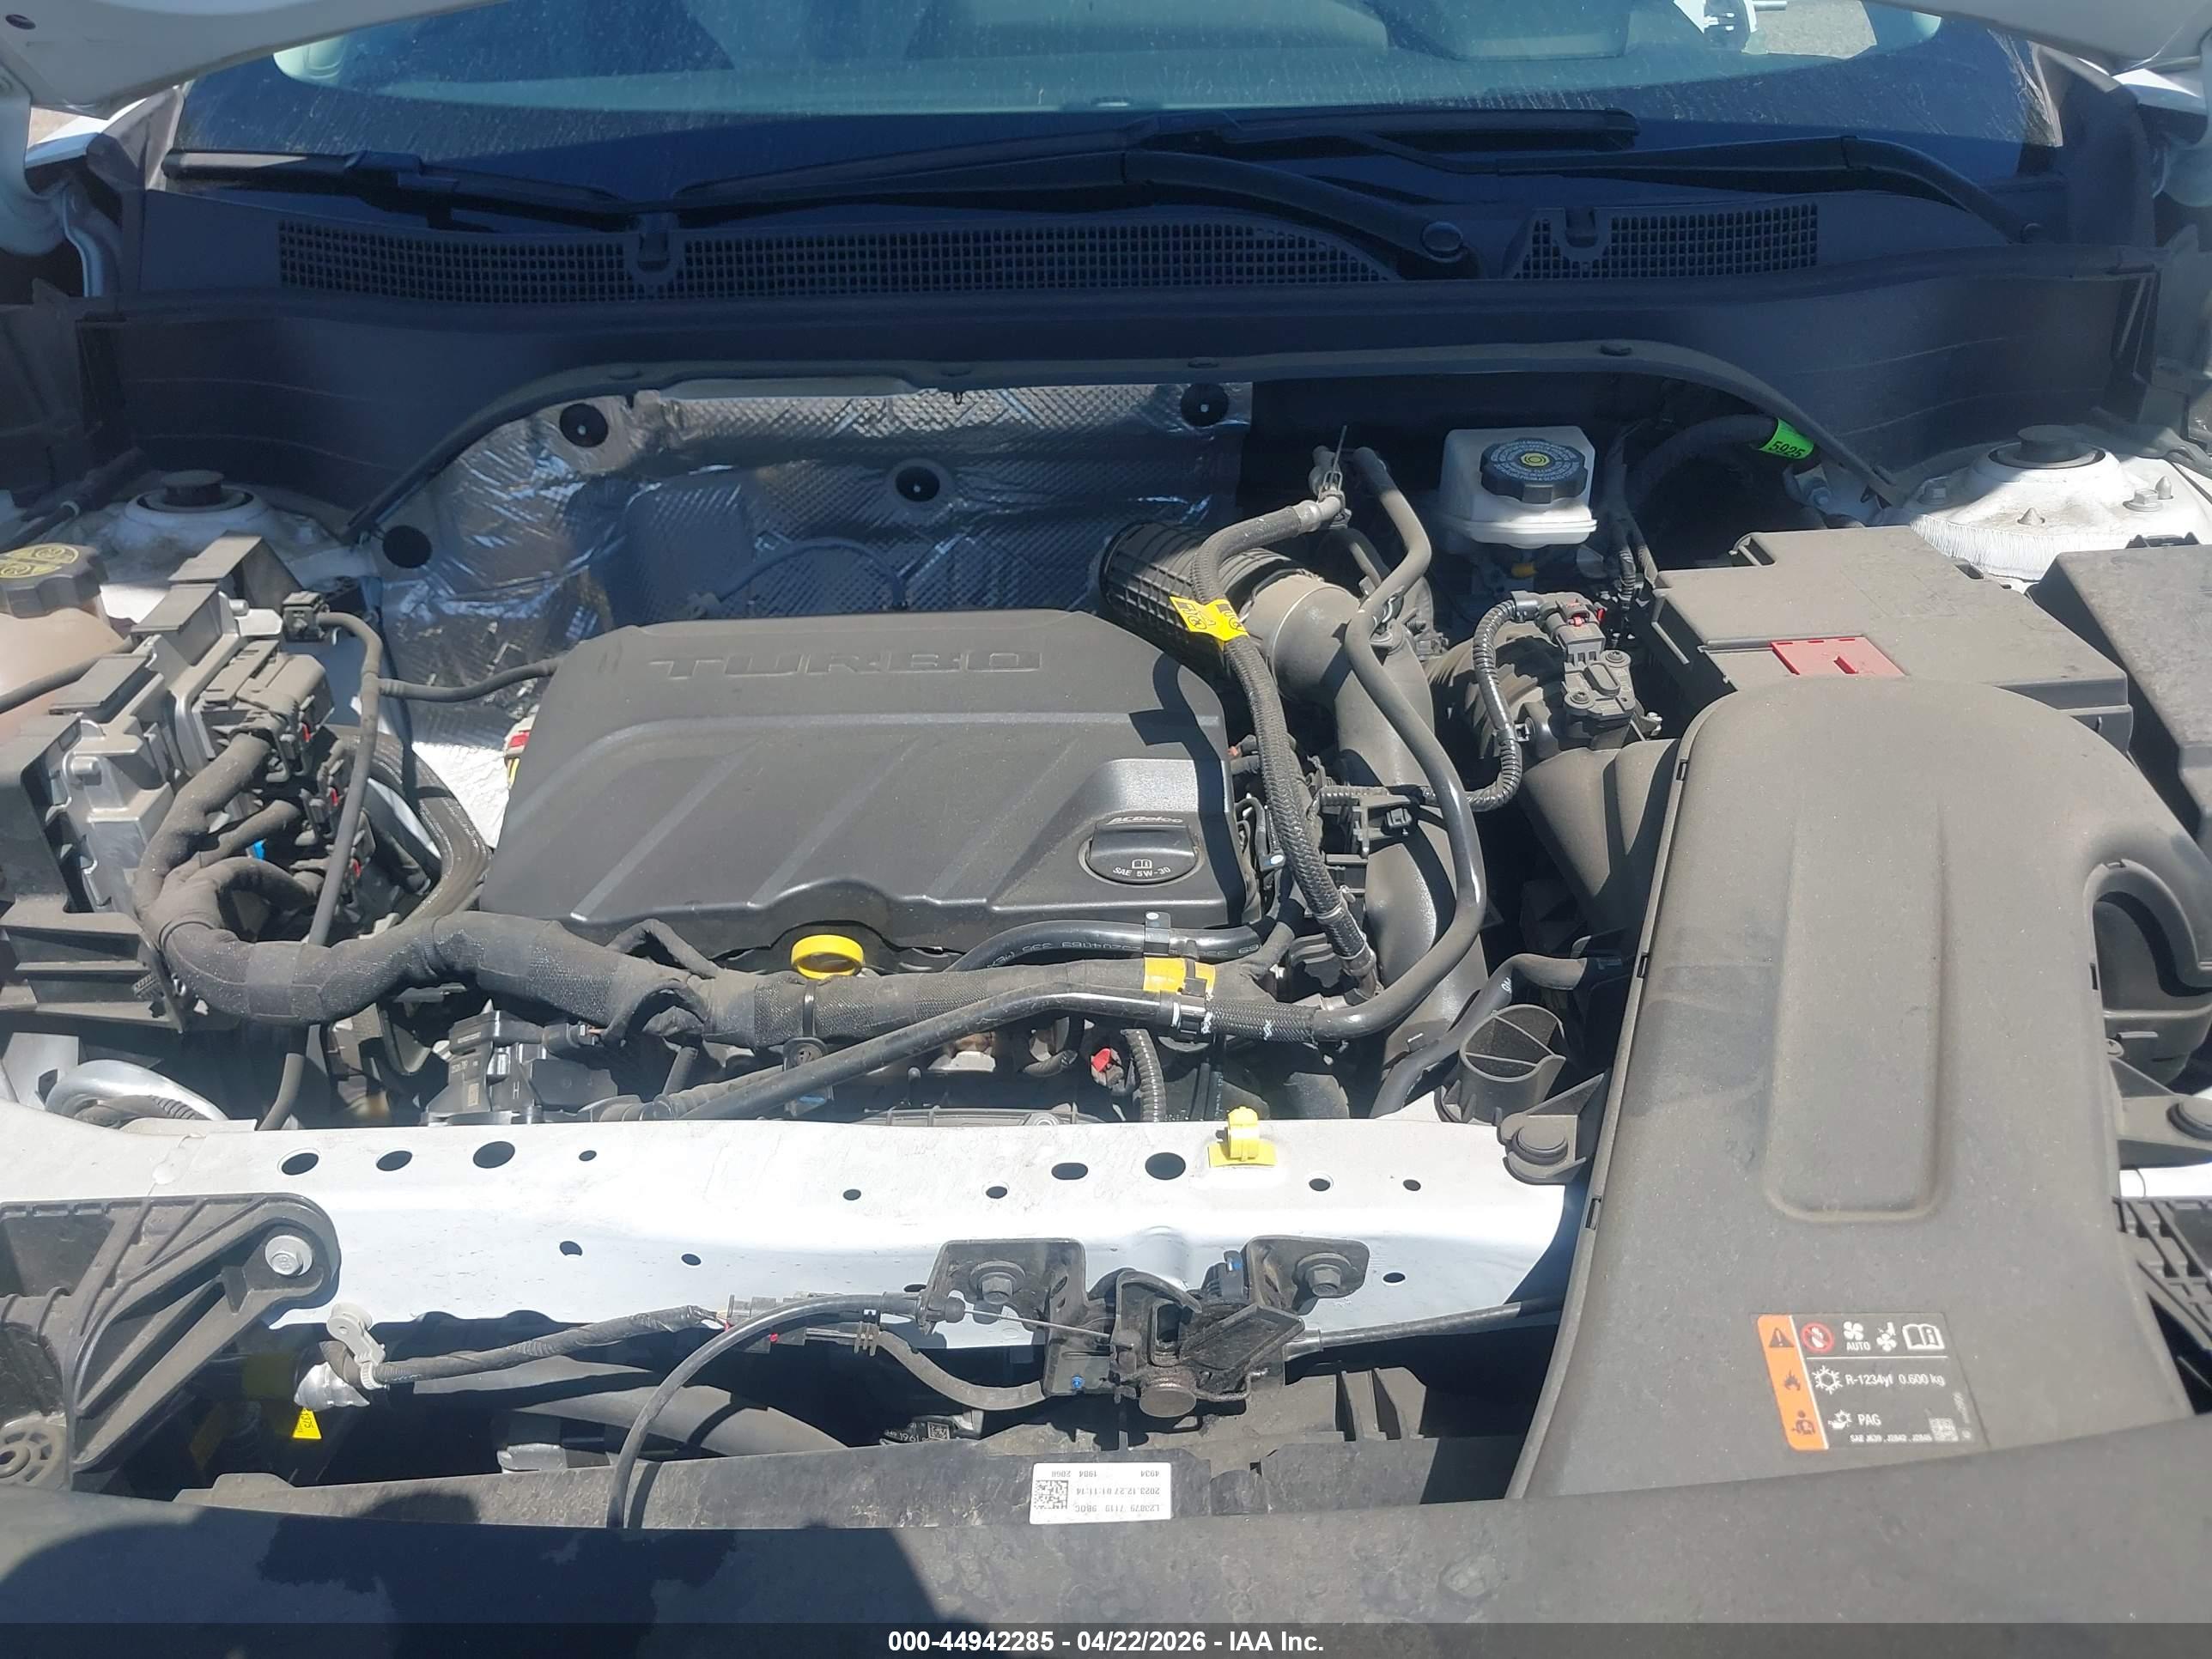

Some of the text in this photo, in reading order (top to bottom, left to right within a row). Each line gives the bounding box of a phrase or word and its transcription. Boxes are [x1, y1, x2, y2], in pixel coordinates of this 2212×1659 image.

[648, 651, 1042, 679] TURBO
[1105, 816, 1183, 825] ACDelco
[1112, 866, 1171, 877] SAE 5W-30
[1846, 1341, 1871, 1352] AUTO
[1845, 1374, 1946, 1388] R-1234yf 0.600 kg
[1856, 1413, 1882, 1426] PAG
